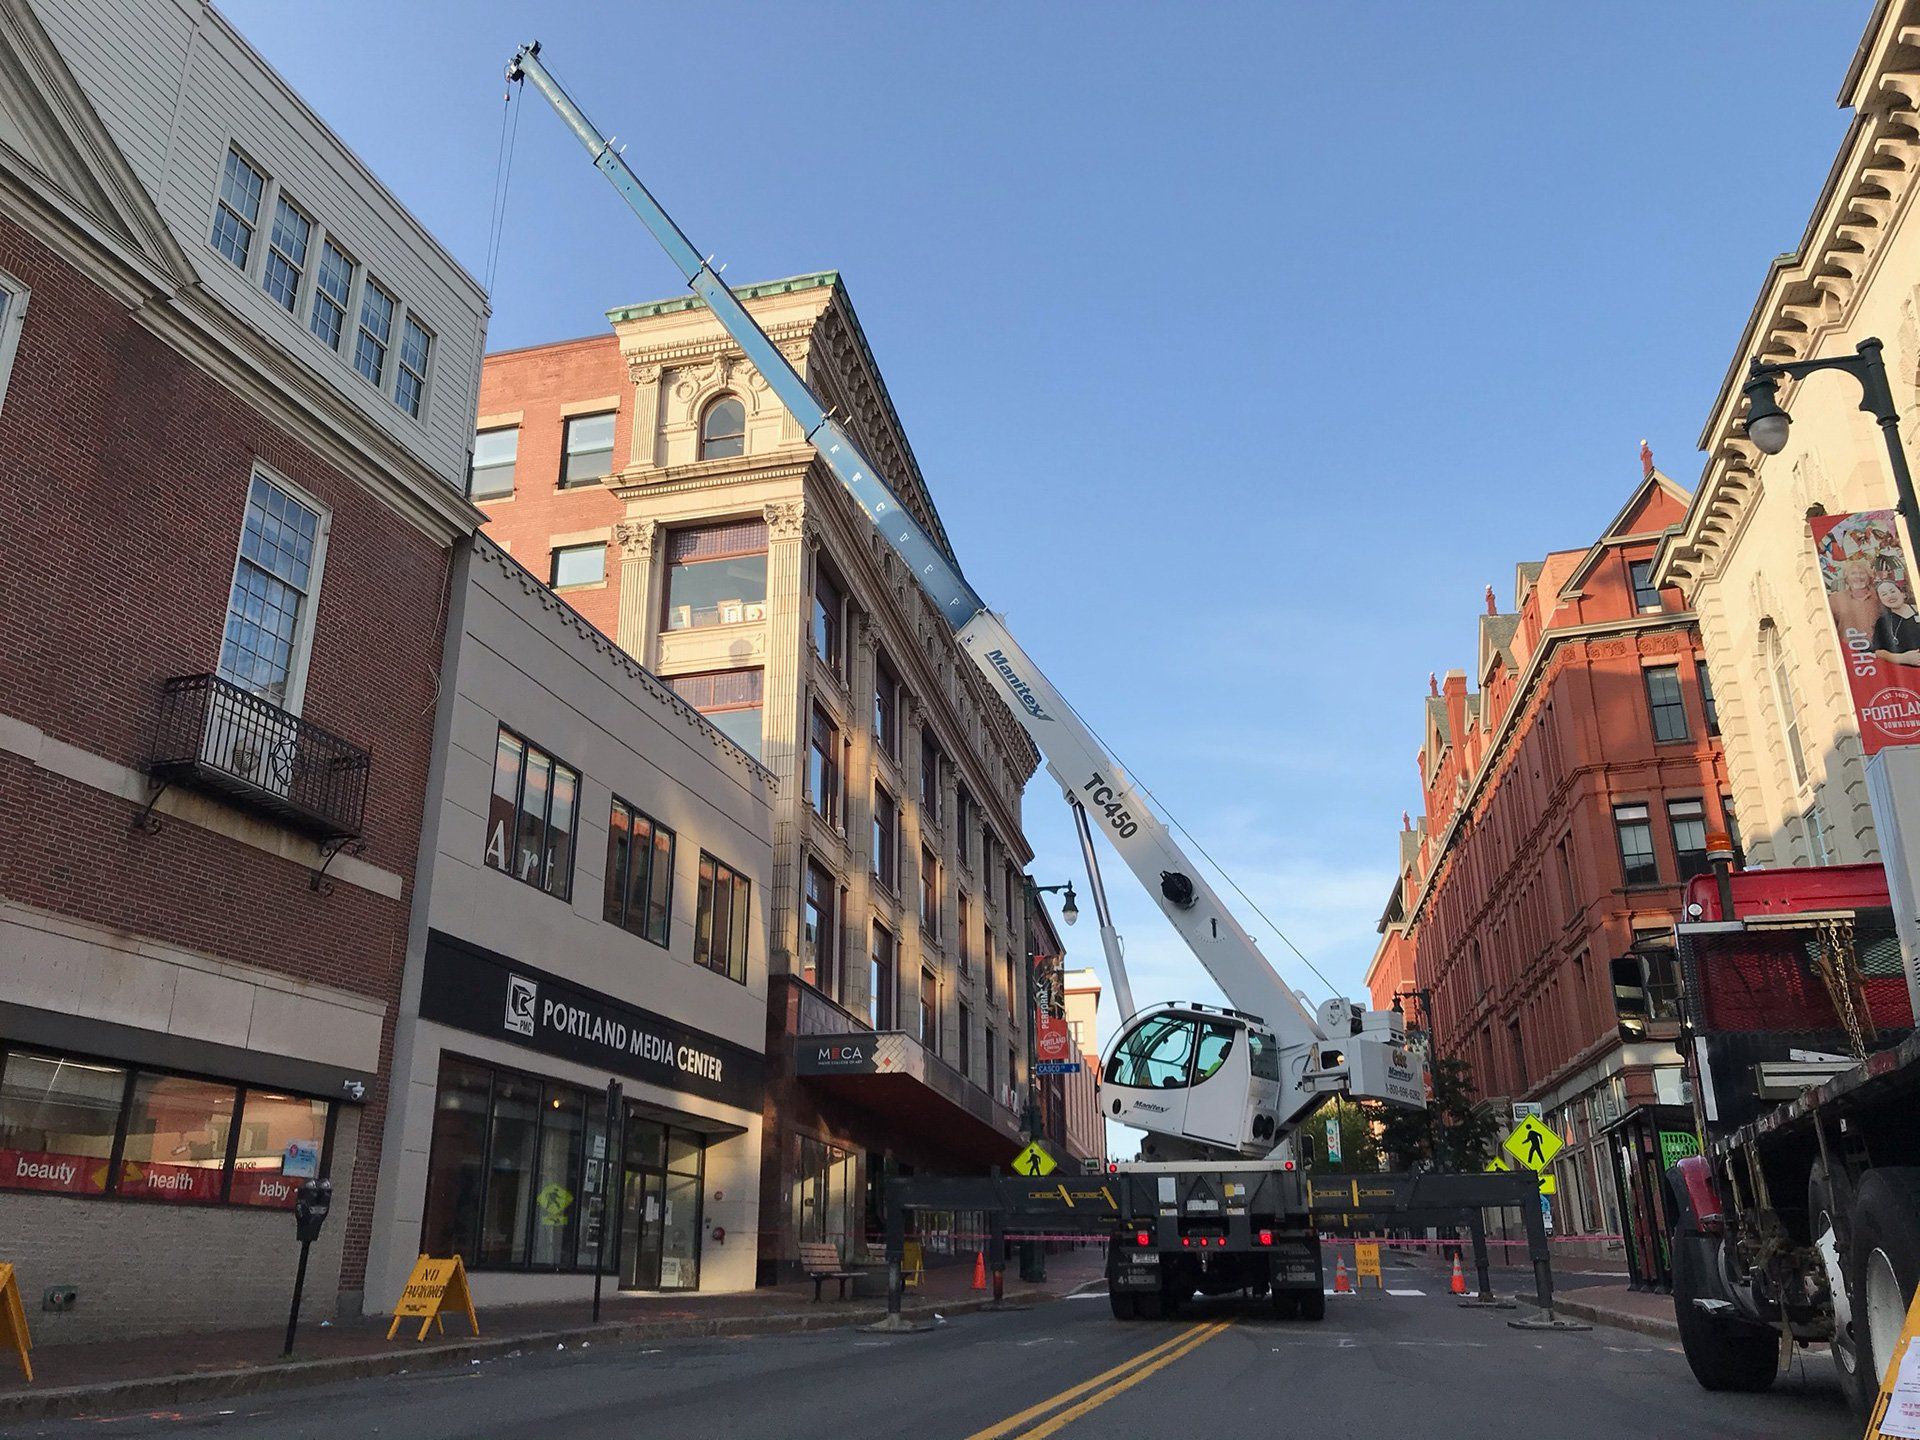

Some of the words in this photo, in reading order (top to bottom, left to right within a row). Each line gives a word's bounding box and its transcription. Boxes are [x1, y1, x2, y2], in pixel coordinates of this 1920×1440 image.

[876, 502, 886, 512] C
[899, 532, 910, 543] D
[924, 564, 934, 575] E
[950, 597, 960, 607] F
[1846, 627, 1877, 677] SHOP
[987, 649, 1045, 717] Manitex
[1083, 772, 1138, 839] TC450
[1211, 917, 1218, 938] 1
[1041, 989, 1049, 1029] PERFORM
[519, 1019, 533, 1033] PMC
[542, 999, 627, 1050] PORTLAND
[629, 1029, 675, 1067] MEDIA
[677, 1046, 723, 1082] CENTER
[1038, 1065, 1060, 1073] CASCO
[1133, 1100, 1164, 1112] Manitex
[16, 1157, 77, 1184] beauty
[218, 1160, 257, 1169] Erance
[148, 1169, 193, 1190] health
[259, 1180, 290, 1201] baby
[421, 1268, 440, 1281] NO
